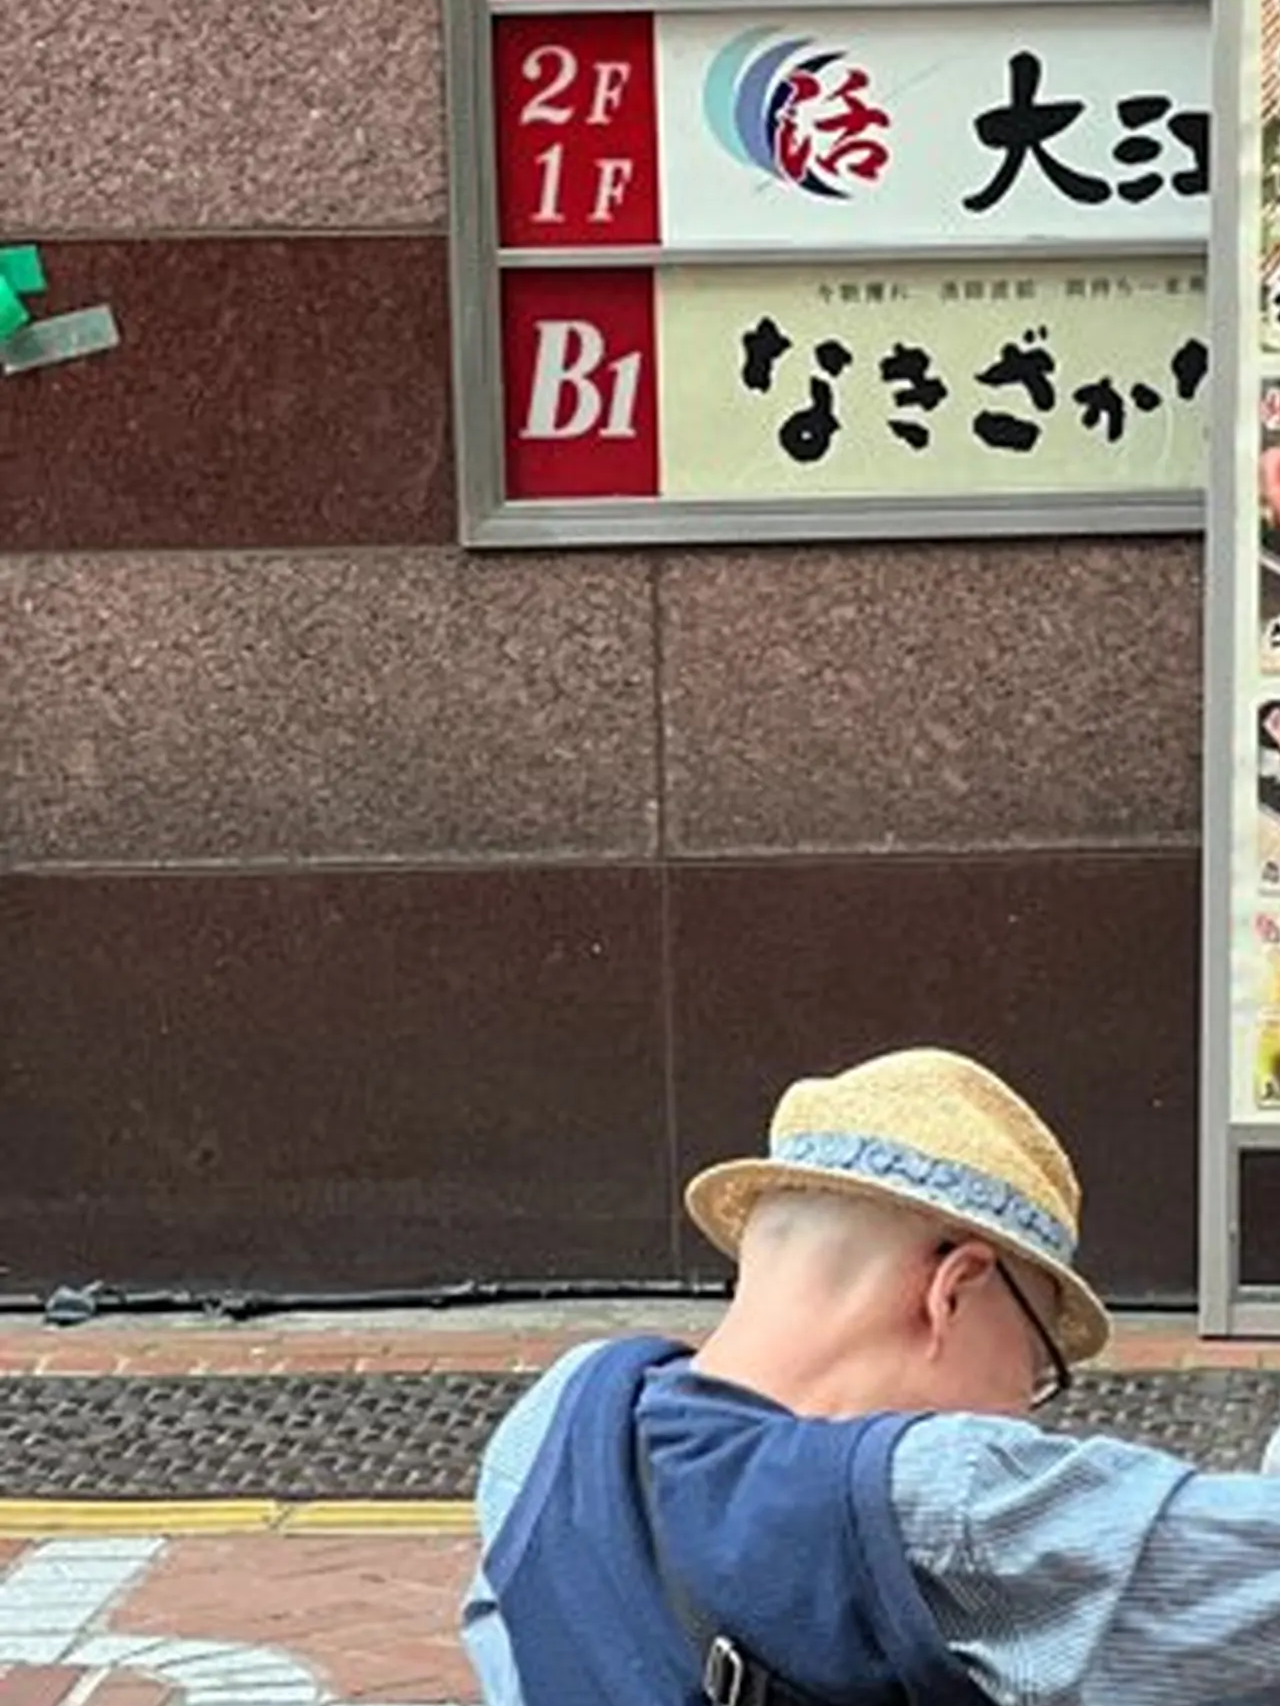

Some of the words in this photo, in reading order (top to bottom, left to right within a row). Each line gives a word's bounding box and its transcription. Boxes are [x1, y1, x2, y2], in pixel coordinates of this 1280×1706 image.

[519, 44, 631, 126] 2F
[776, 68, 891, 182] 活
[530, 142, 633, 224] 1F
[518, 319, 643, 442] B1
